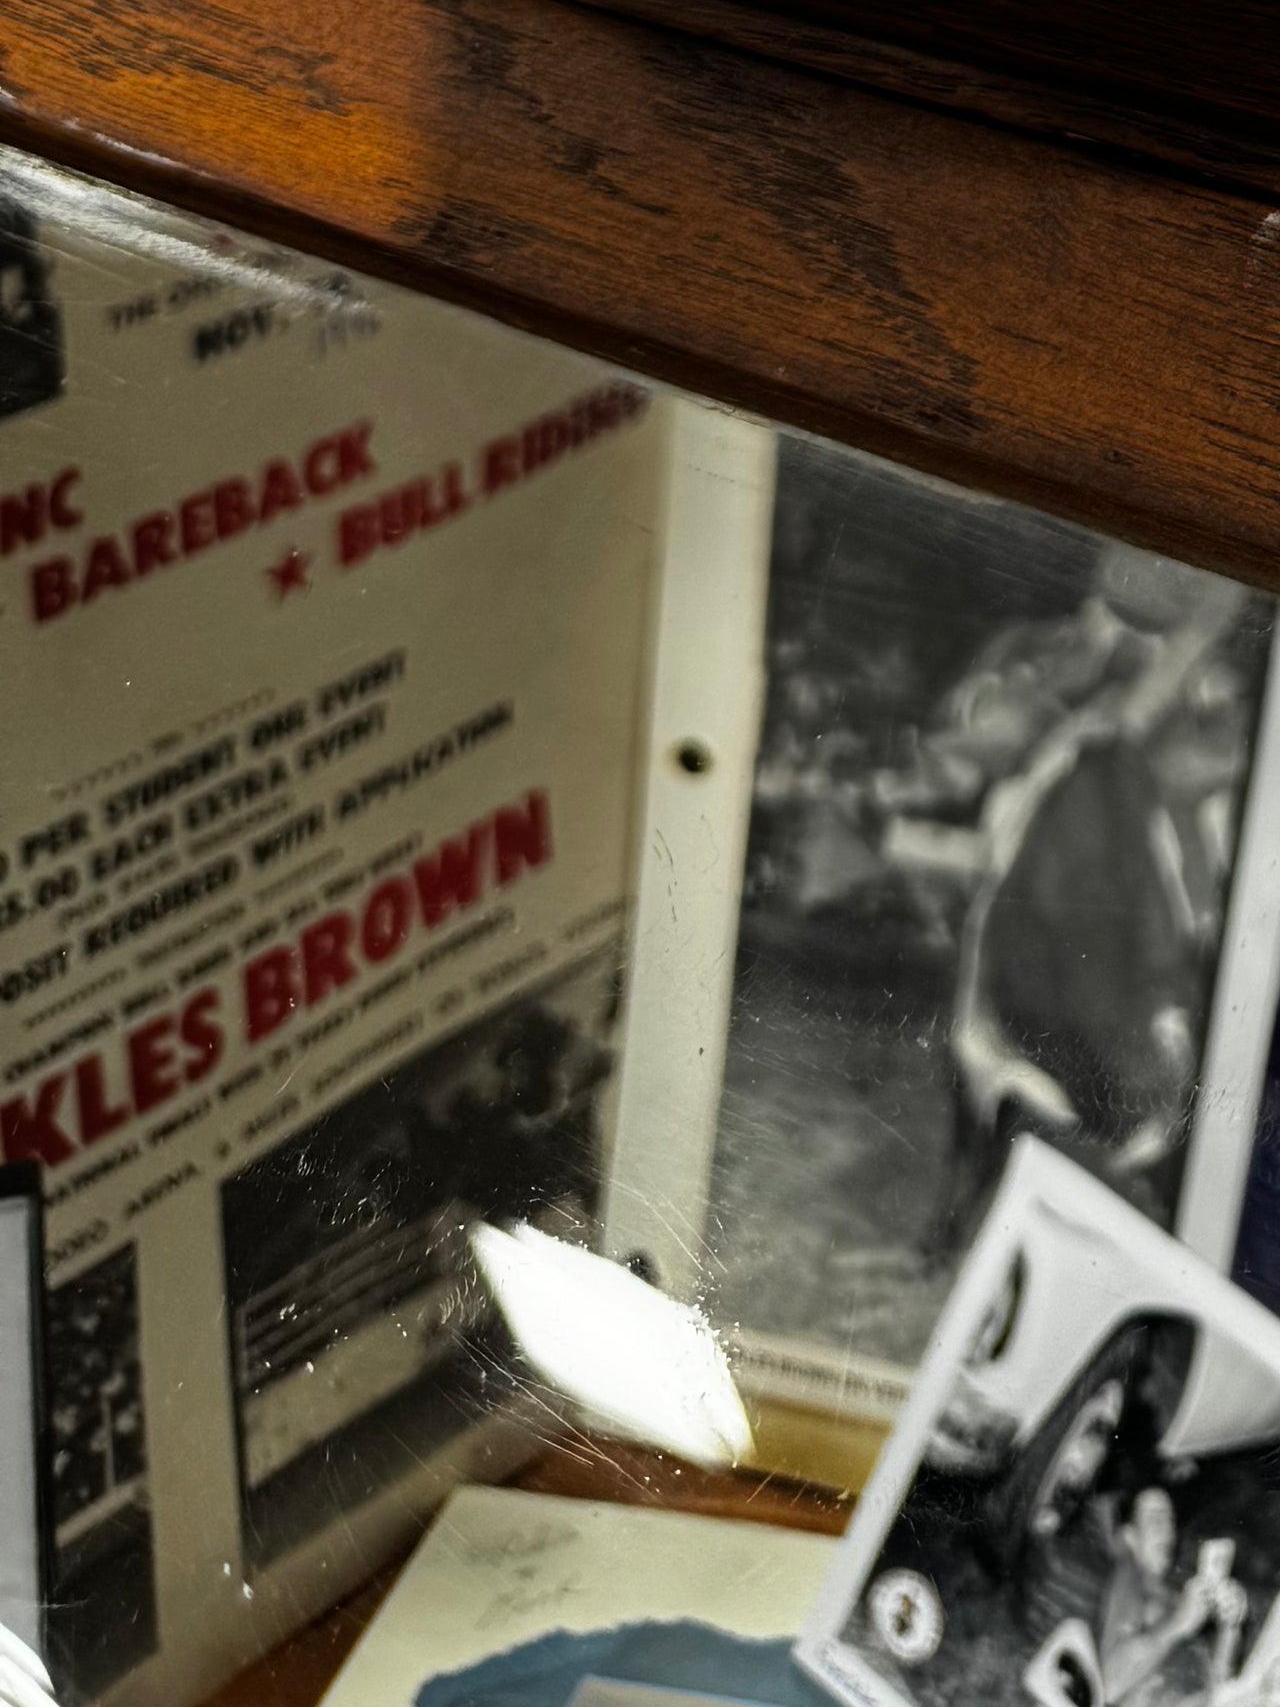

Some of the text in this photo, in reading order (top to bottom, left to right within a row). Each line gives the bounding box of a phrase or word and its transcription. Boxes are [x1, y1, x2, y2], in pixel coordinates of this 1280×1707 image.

[29, 417, 378, 626] BAREBACK
[335, 458, 474, 573] BULL
[242, 790, 557, 1048] BROWN
